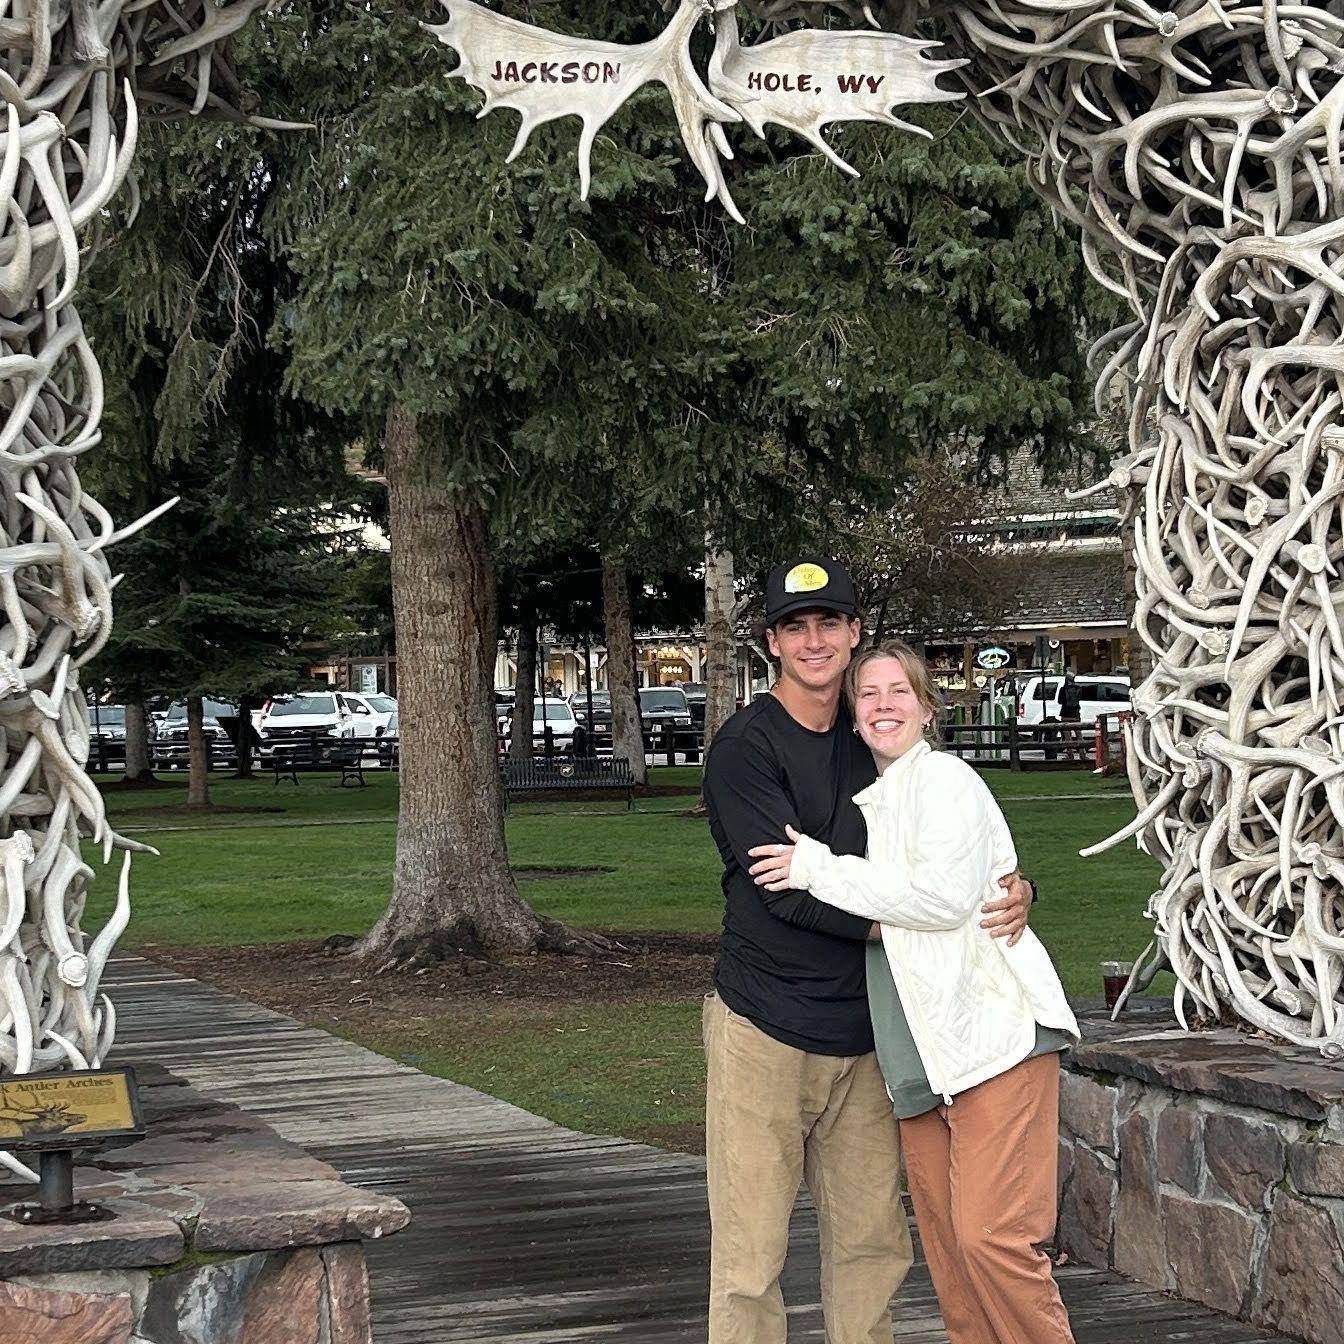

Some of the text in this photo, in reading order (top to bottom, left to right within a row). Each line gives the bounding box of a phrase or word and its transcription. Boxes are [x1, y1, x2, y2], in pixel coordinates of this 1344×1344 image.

[490, 60, 885, 95] JACKSON HOLE, WY
[16, 1080, 60, 1092] Antler
[65, 1077, 113, 1088] Arches
